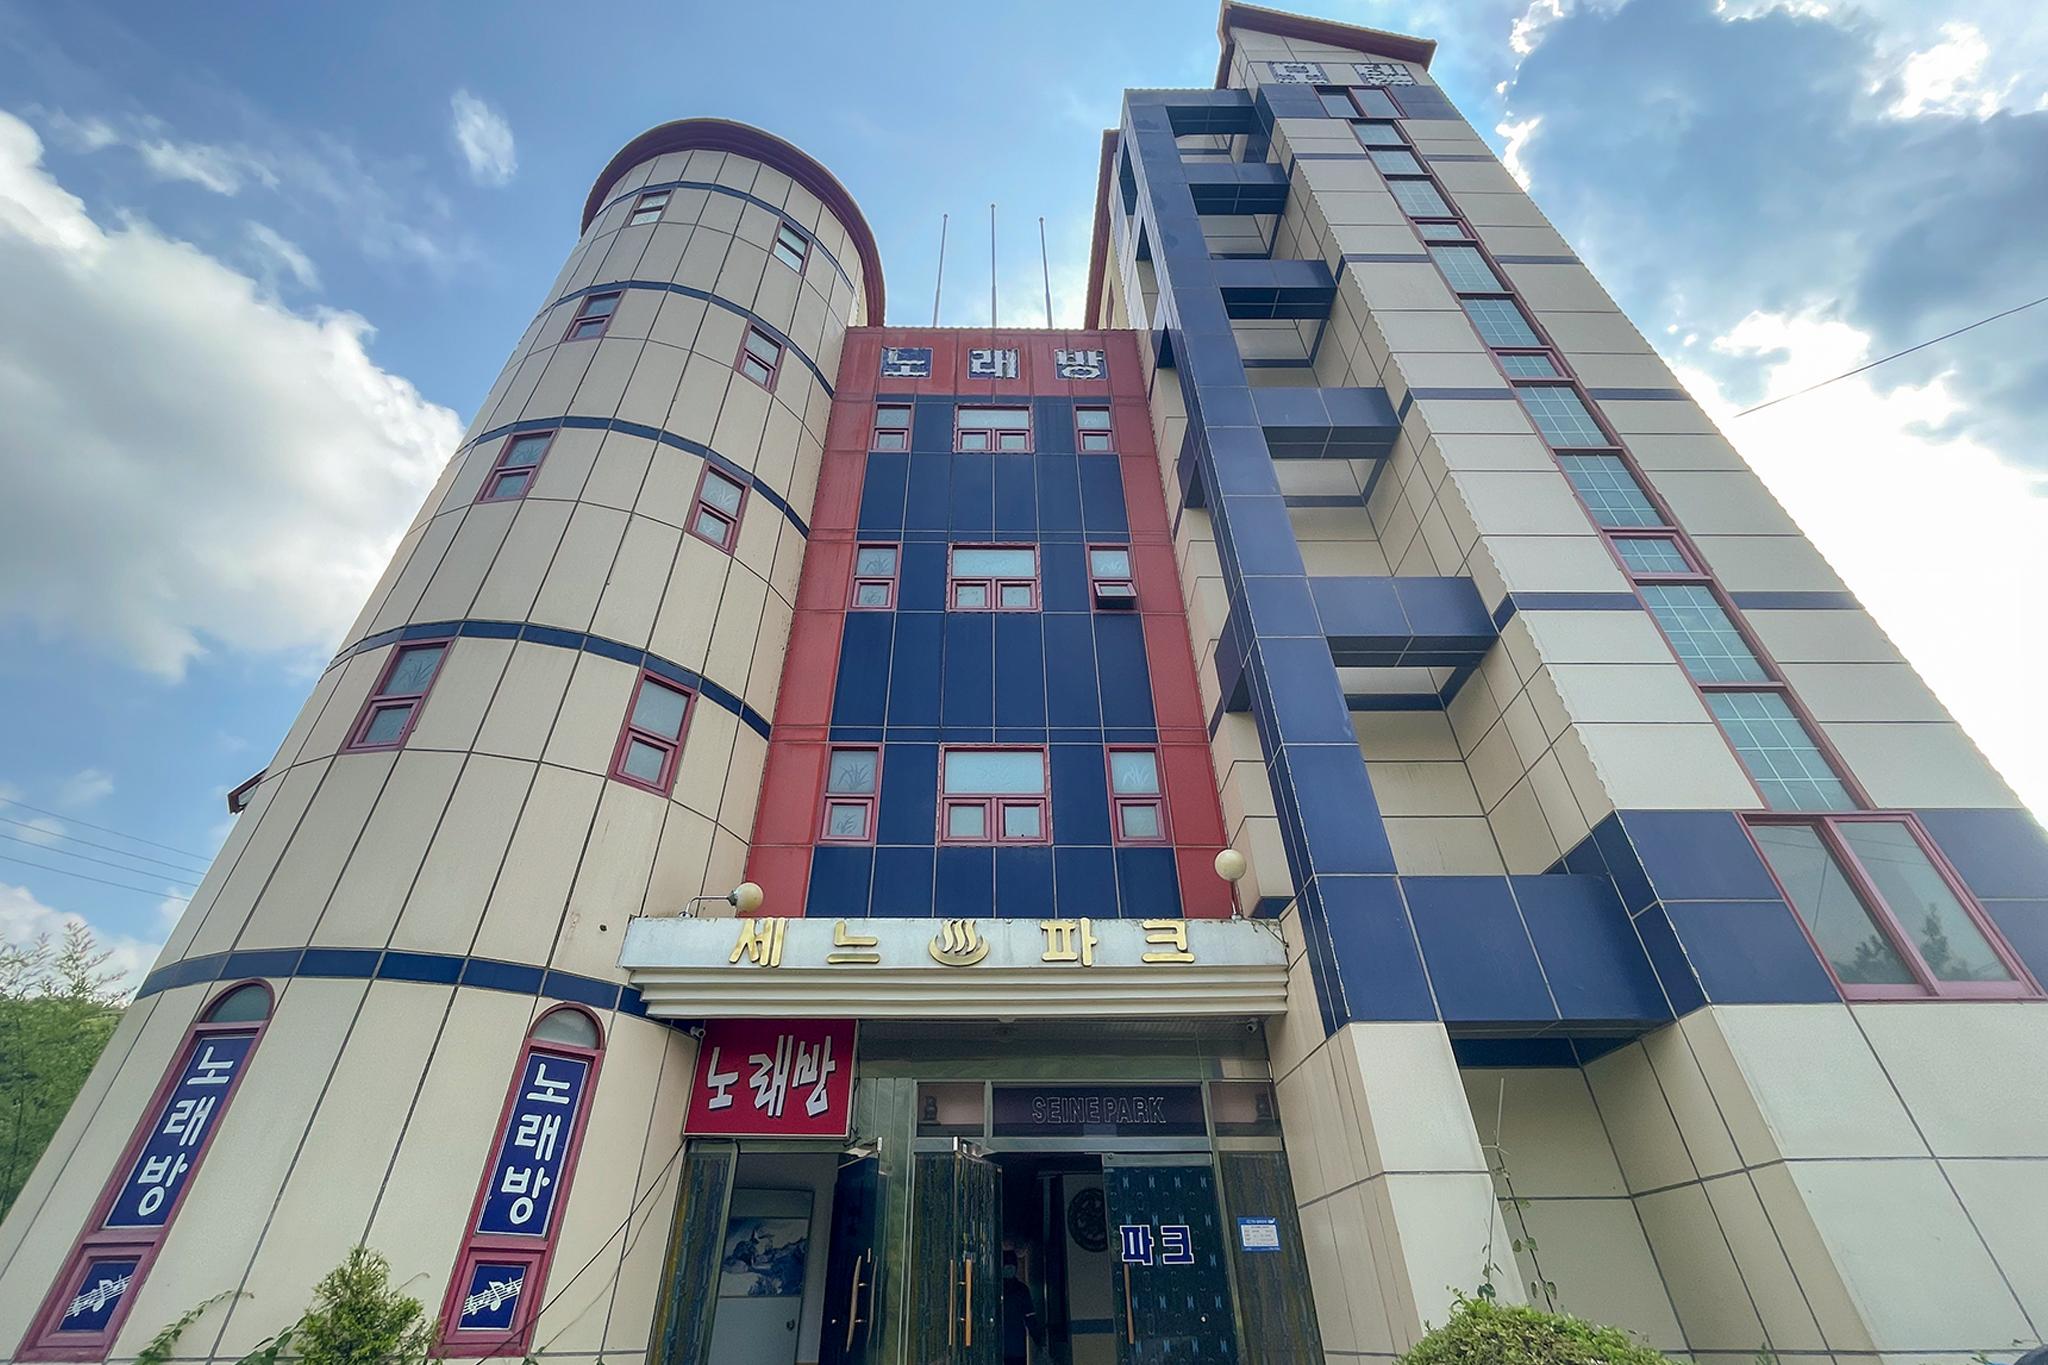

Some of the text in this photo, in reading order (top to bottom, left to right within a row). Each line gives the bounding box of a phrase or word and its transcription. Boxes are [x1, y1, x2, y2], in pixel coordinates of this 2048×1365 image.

[882, 347, 1106, 379] 노래방
[728, 917, 1196, 968] 세느 파크
[707, 1034, 836, 1117] 노래방
[136, 1045, 234, 1218] 노래방
[1032, 1097, 1166, 1124] SEINE PARK
[502, 1063, 571, 1225] 노래방
[1120, 1225, 1194, 1265] 파크
